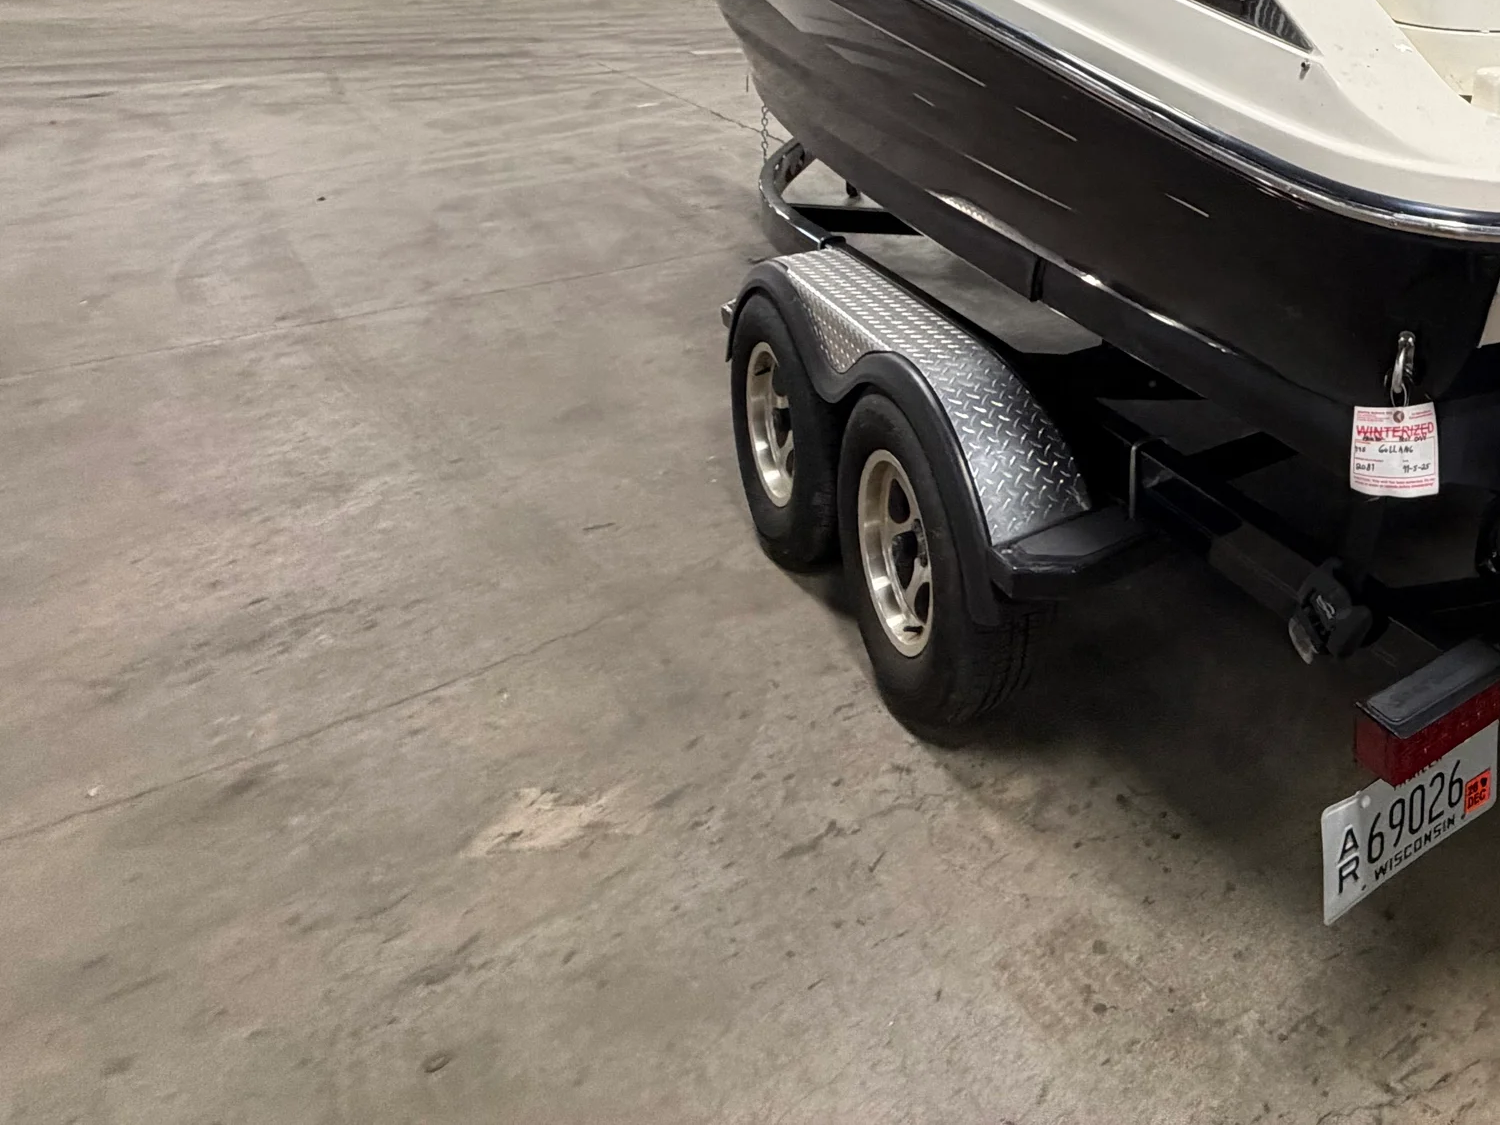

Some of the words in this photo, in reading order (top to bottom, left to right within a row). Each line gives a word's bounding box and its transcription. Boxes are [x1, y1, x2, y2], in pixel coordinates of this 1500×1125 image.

[1356, 421, 1434, 439] WINTERIZED
[1366, 759, 1464, 864] 69026
[1467, 788, 1487, 809] DEC
[1373, 813, 1456, 881] WISCONSIN
